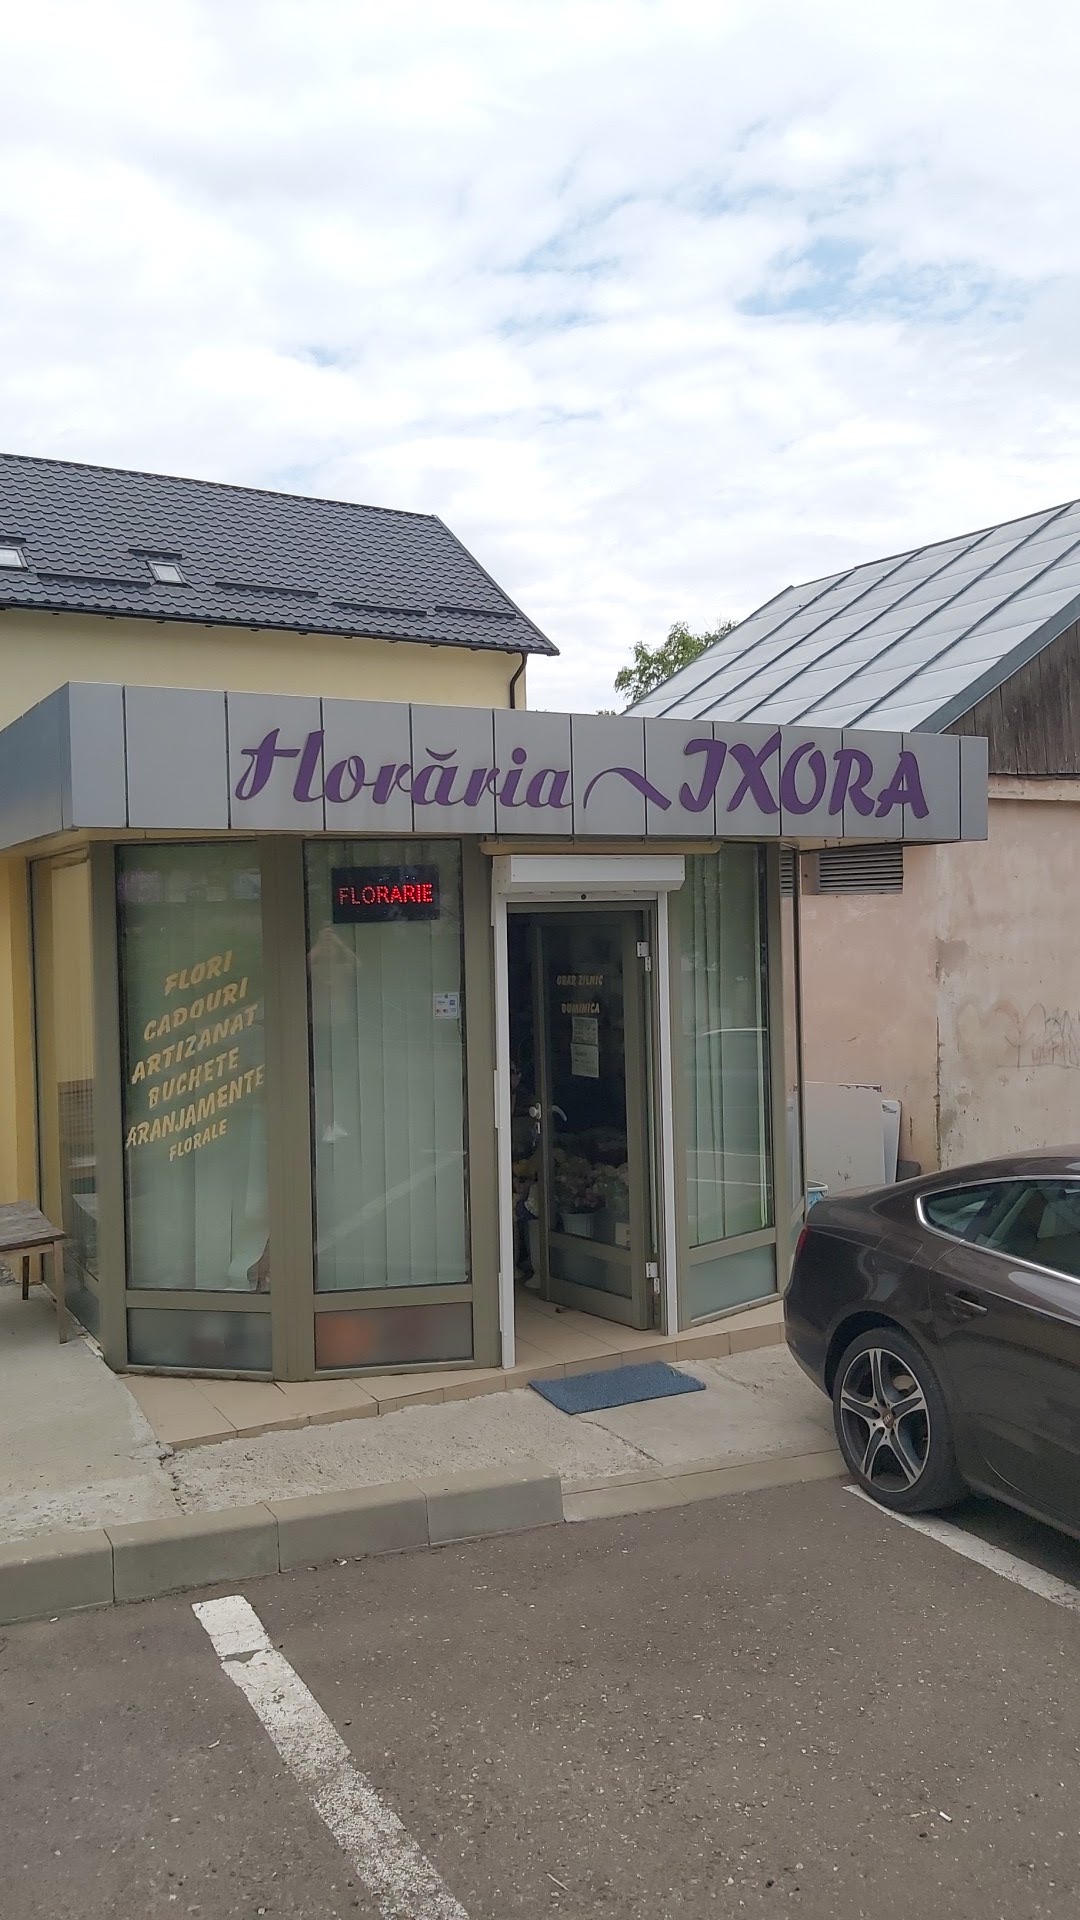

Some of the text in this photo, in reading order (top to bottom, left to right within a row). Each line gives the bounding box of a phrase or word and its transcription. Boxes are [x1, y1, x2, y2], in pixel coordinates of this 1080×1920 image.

[679, 731, 929, 819] IXORA
[338, 883, 433, 905] FLORARIE
[164, 950, 233, 996] FLORI
[577, 974, 604, 986] ZILNIC
[143, 977, 248, 1041] CADOURI
[131, 1004, 258, 1084] ARTIZANAT
[125, 1064, 265, 1148] ARANJAMENTE
[148, 1047, 240, 1109] BUCHETE
[169, 1119, 228, 1162] FLORALE
